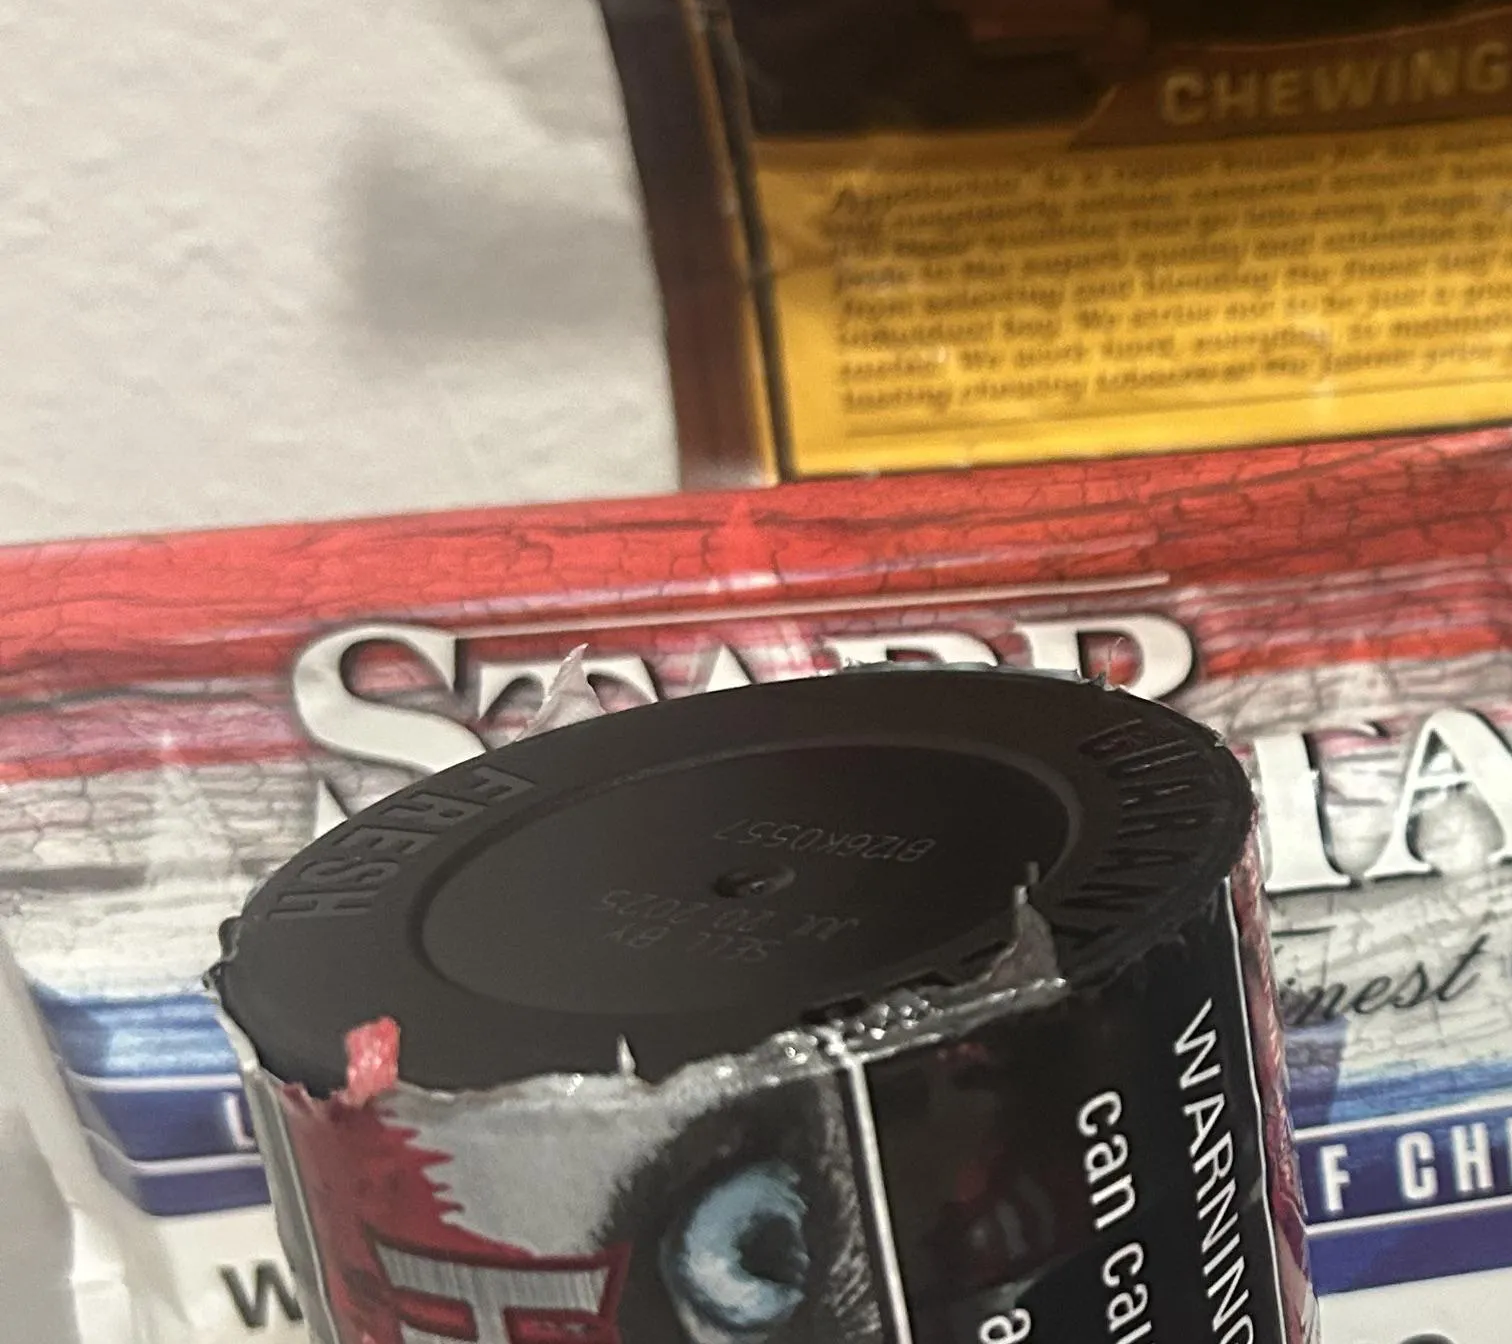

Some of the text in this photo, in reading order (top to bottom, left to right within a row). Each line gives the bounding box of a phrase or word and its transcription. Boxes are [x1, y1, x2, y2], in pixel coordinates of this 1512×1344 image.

[1159, 39, 1512, 126] CHEWING
[266, 764, 538, 922] FRESH
[1268, 921, 1490, 1028] inest
[1075, 1088, 1139, 1232] can
